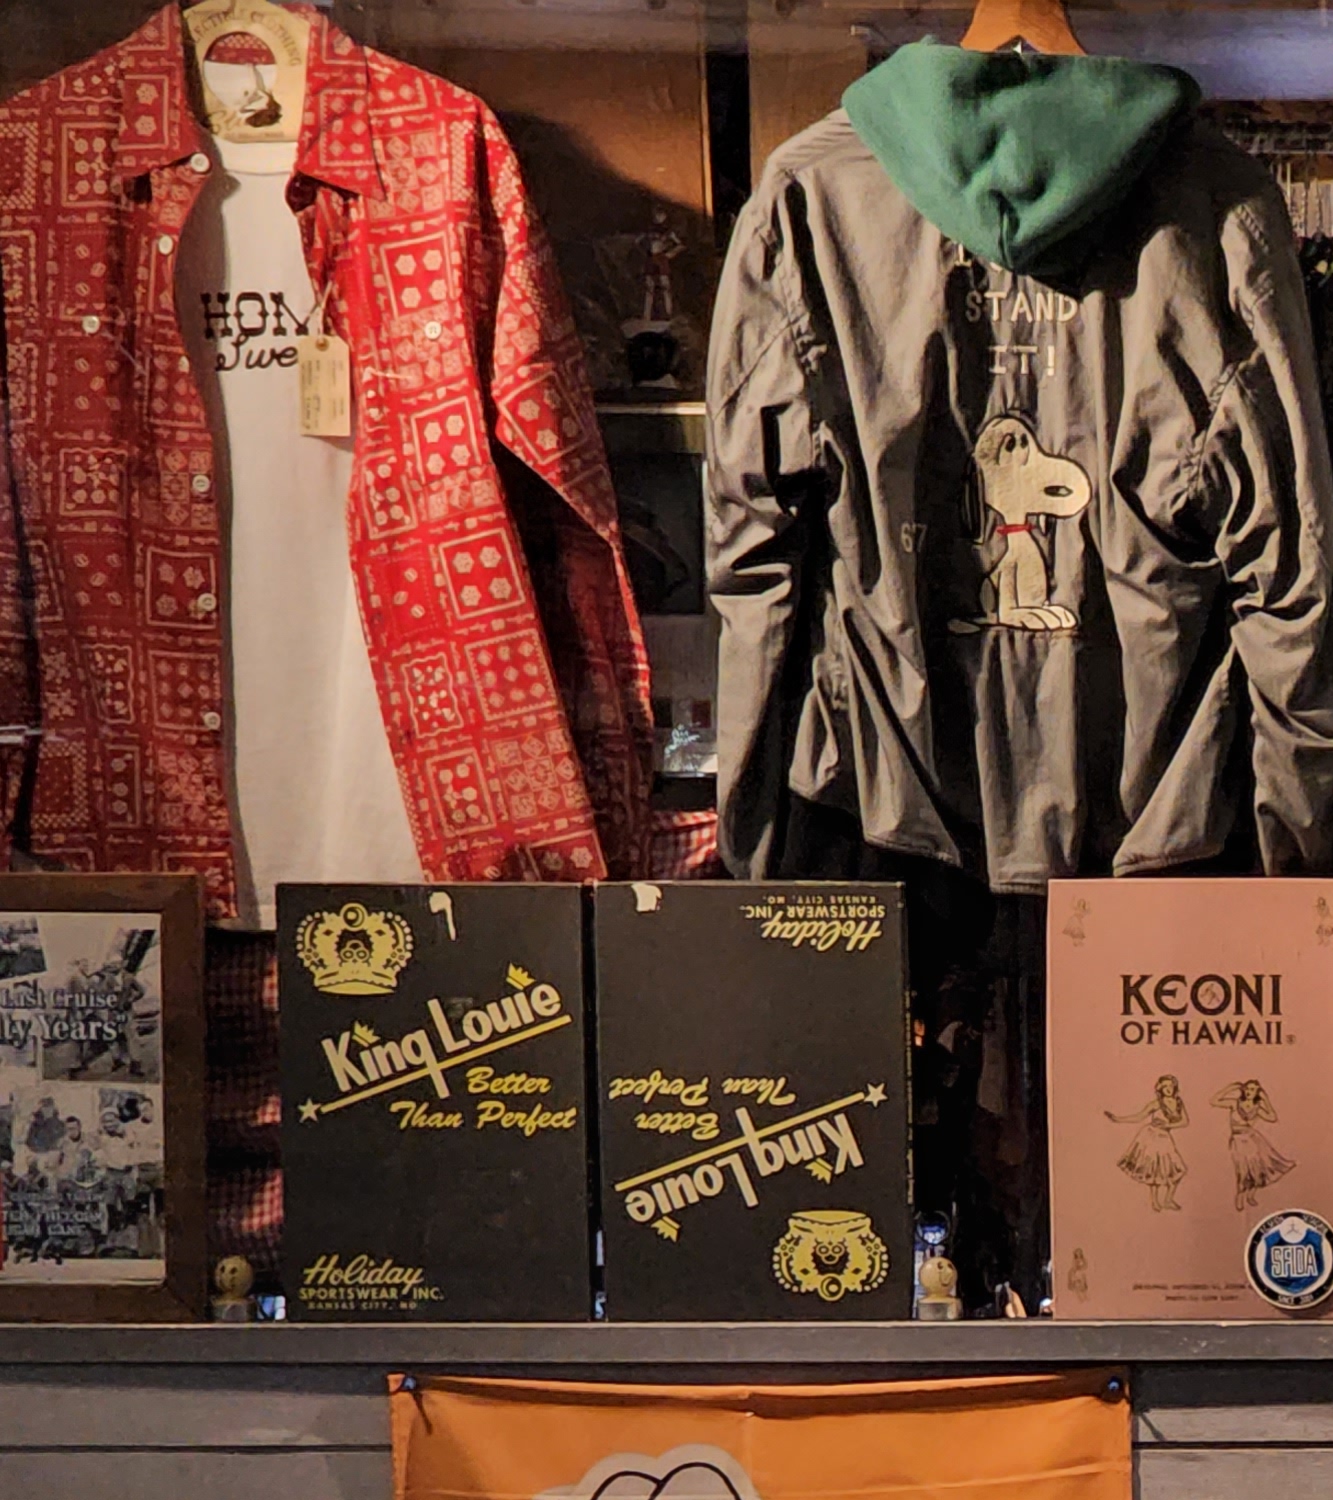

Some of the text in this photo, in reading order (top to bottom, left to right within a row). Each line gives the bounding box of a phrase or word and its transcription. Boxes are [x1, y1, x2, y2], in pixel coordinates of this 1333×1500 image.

[965, 290, 1078, 323] STAND
[989, 345, 1056, 377] IT!
[787, 905, 886, 919] SPORTSWEAR
[761, 910, 883, 952] Holiday
[54, 990, 119, 1008] Cruise
[1120, 973, 1283, 1017] KEONI
[321, 972, 562, 1099] King Louie
[1120, 1020, 1283, 1046] OF HAWAII
[465, 1066, 552, 1094] Better
[608, 1069, 797, 1107] Than Perfect
[389, 1100, 578, 1137] Than Perfect
[634, 1111, 720, 1141] Better
[625, 1107, 865, 1232] King Louie
[303, 1254, 425, 1296] Holiday
[1270, 1244, 1319, 1279] SFIDA
[299, 1286, 445, 1300] SPORTSWEAR INC.
